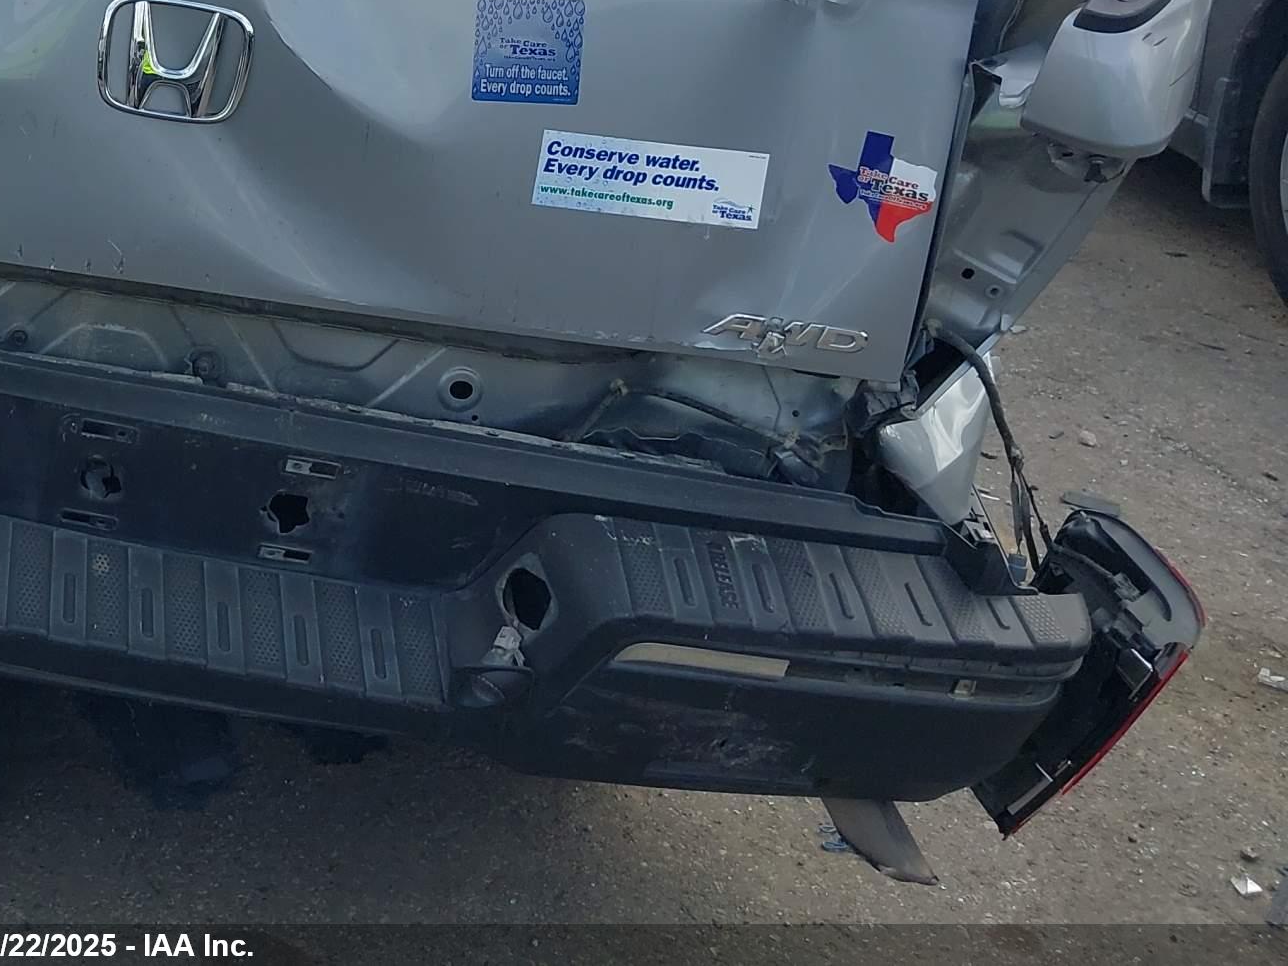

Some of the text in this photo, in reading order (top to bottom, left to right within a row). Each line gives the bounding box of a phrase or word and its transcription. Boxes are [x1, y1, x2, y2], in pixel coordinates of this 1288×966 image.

[510, 44, 556, 56] Texas
[523, 40, 548, 48] Care
[485, 64, 569, 81] Turn off the faucet.
[480, 78, 571, 97] Every drop counts.
[546, 140, 701, 172] Conserve water.
[543, 158, 720, 192] Every drop counts.
[859, 166, 919, 190] Take Care
[540, 185, 674, 210] www.takecareoftexas.org
[871, 178, 929, 202] Texas
[719, 210, 753, 221] Texas
